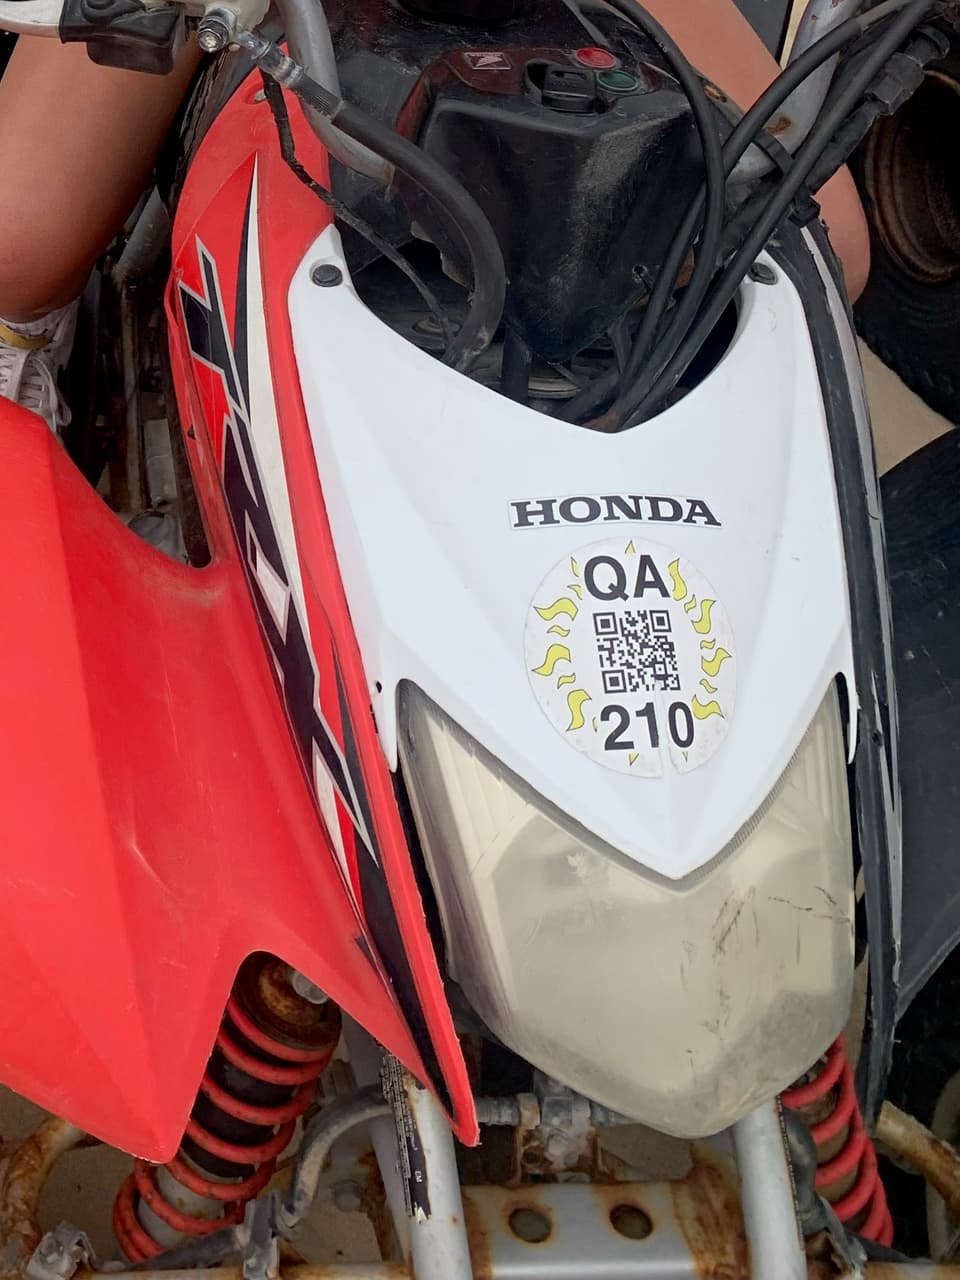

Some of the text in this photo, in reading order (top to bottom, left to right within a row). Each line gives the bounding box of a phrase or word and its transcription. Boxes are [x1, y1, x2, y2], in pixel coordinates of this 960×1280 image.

[510, 495, 722, 527] HONDA
[584, 554, 671, 602] QA
[600, 701, 695, 751] 210
